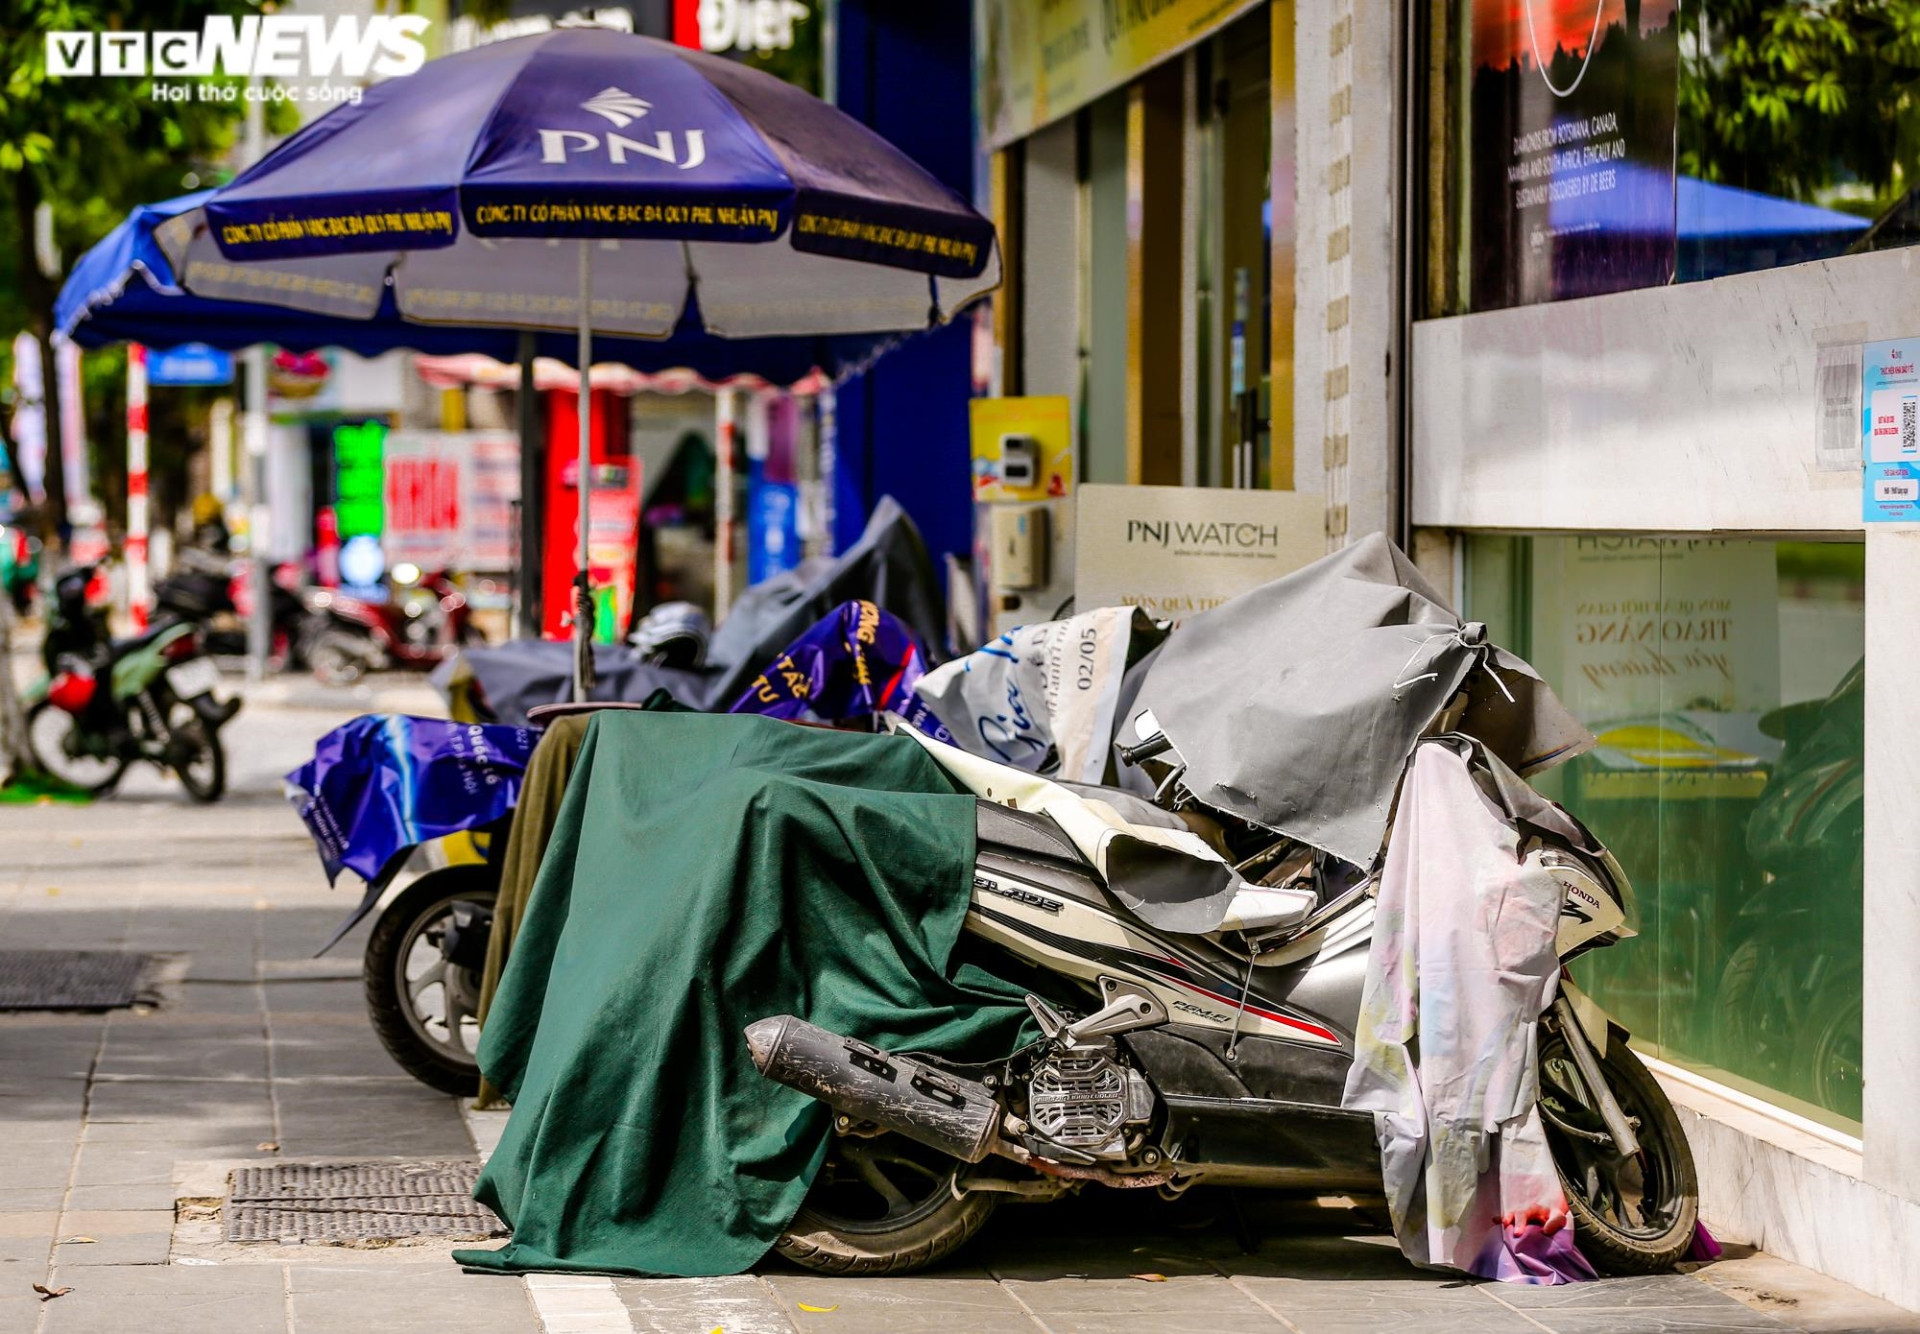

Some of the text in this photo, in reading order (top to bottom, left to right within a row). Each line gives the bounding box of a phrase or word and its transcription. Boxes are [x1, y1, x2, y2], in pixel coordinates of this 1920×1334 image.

[1591, 111, 1619, 137] CANADA,
[538, 129, 704, 170] PNJ
[1612, 138, 1626, 159] AND
[1127, 520, 1278, 547] PNJ WATCH
[1077, 627, 1097, 690] 02/05
[1563, 880, 1600, 909] HONDA
